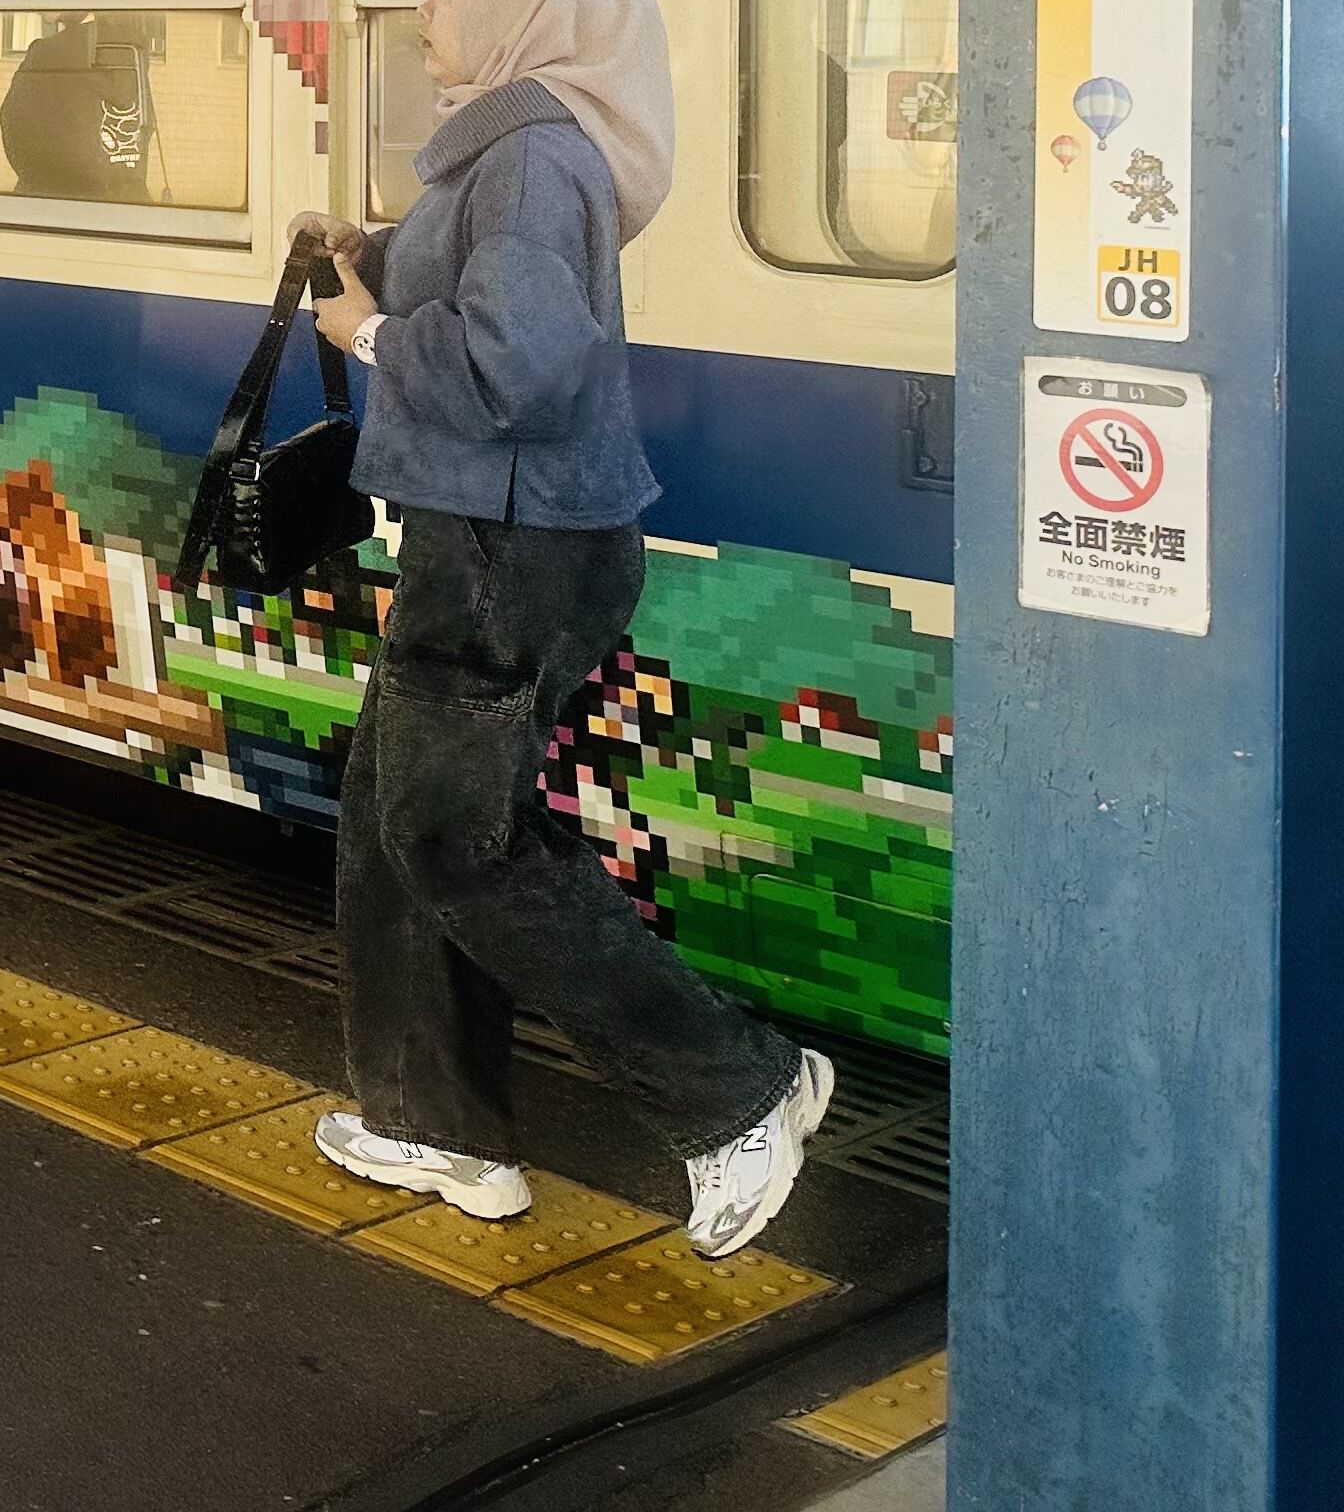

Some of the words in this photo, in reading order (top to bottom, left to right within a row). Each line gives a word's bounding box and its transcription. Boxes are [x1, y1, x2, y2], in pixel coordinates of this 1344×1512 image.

[1118, 248, 1159, 273] JH
[1105, 276, 1172, 320] 08
[1078, 381, 1145, 400] お願い
[1039, 511, 1186, 562] 全面禁煙
[1062, 550, 1084, 565] No
[1088, 554, 1161, 580] Smoking
